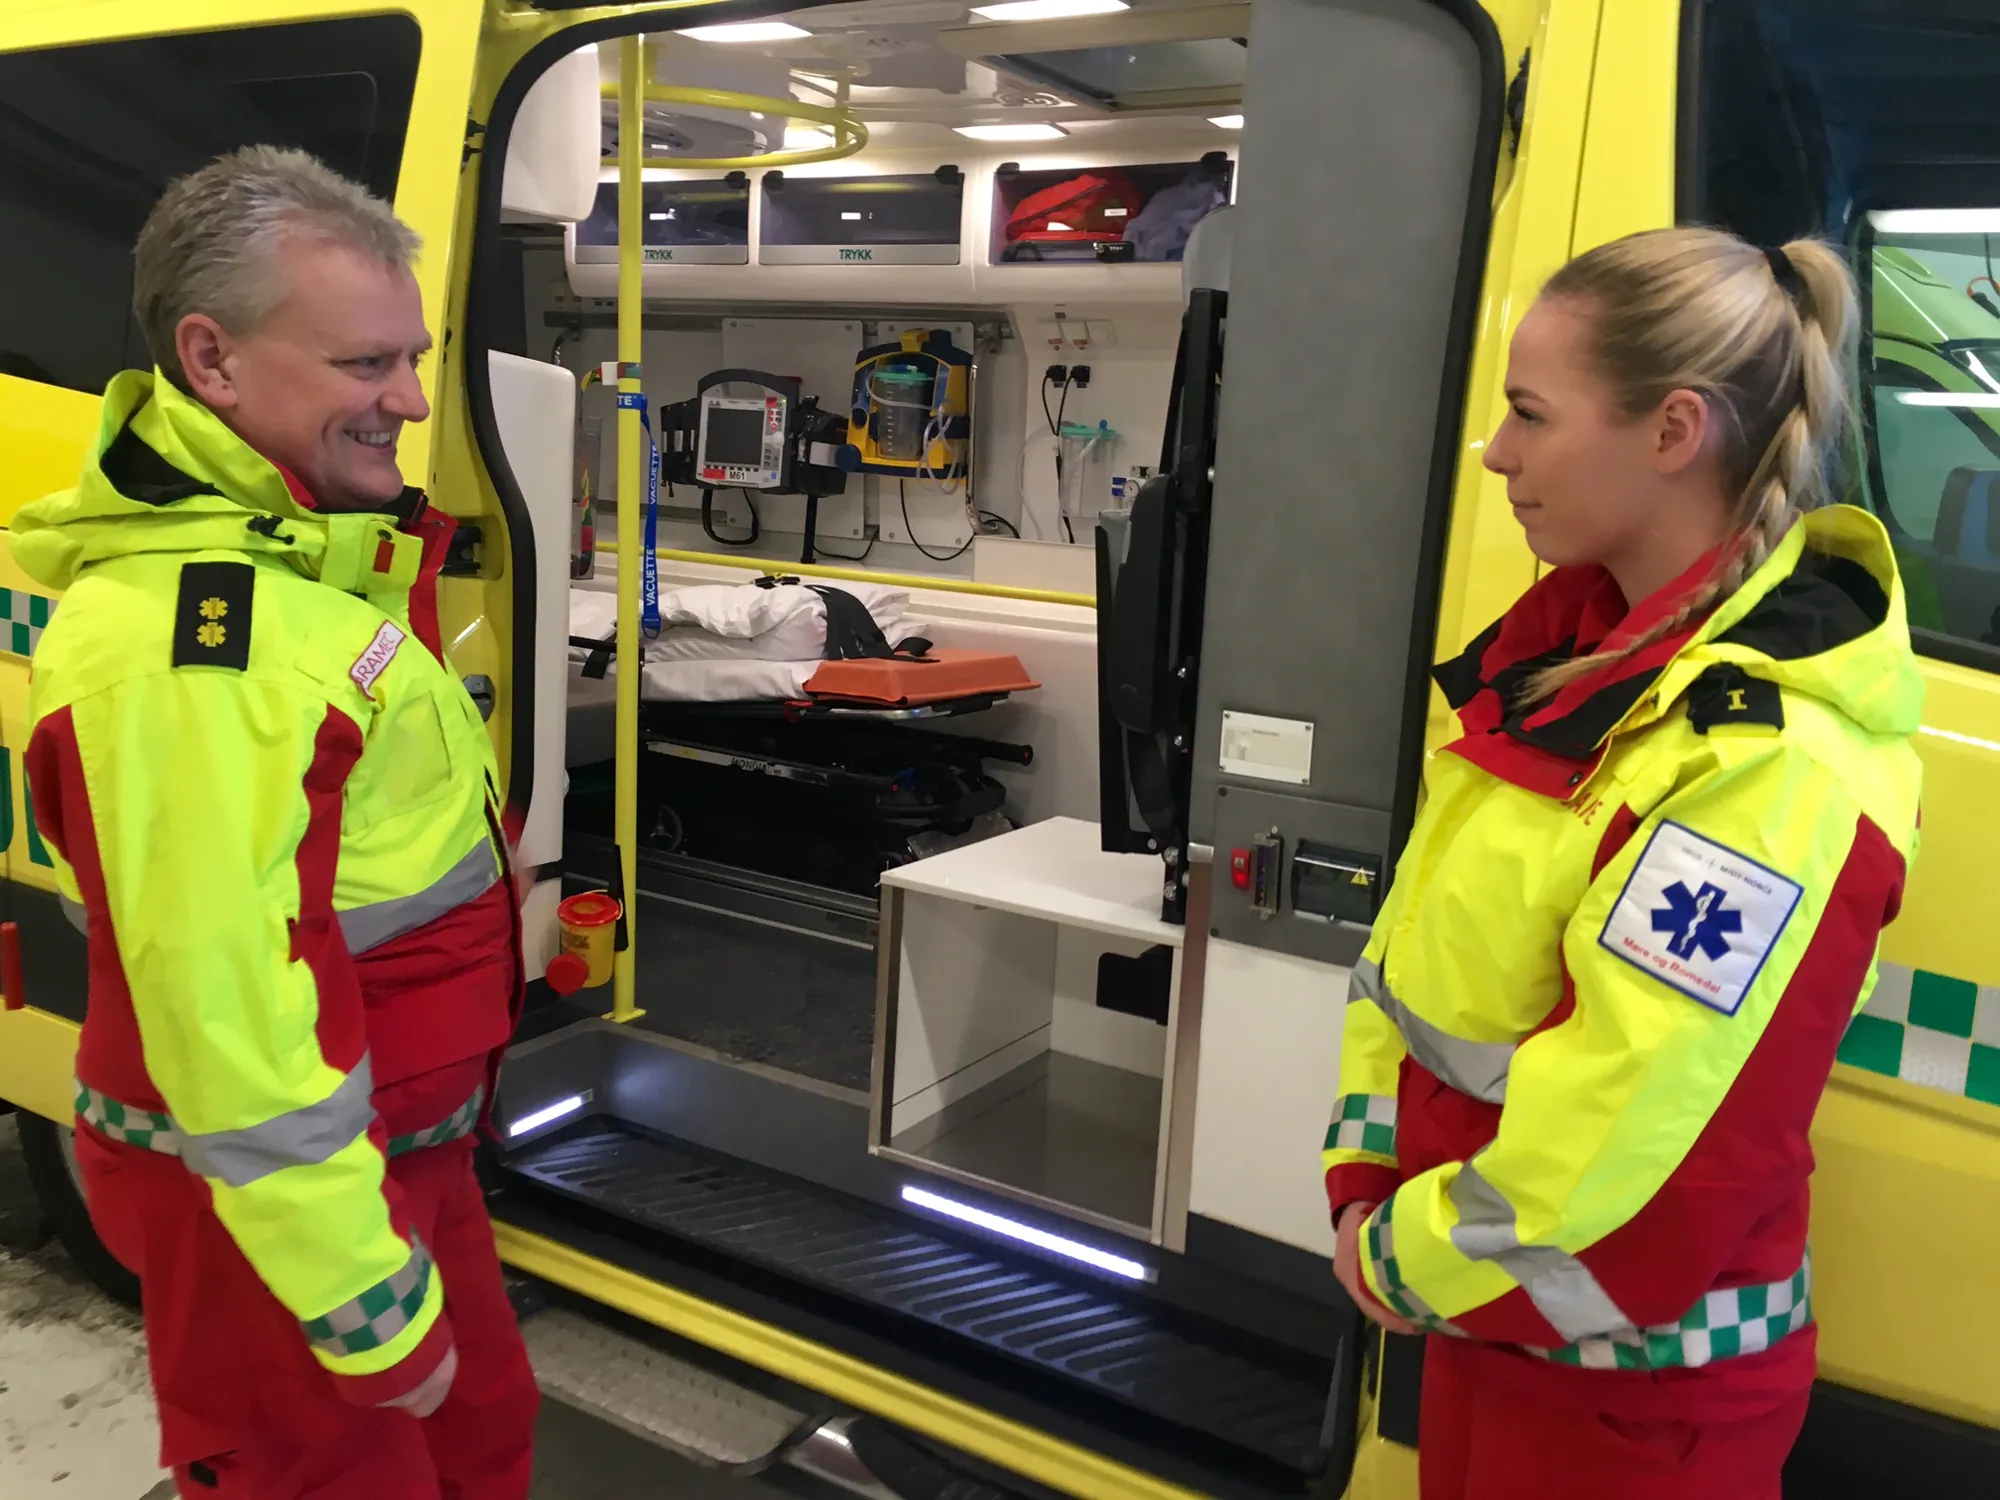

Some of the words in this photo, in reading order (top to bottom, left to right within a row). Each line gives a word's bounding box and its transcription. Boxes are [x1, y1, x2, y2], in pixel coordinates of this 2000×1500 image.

[644, 249, 673, 261] TRYKK
[839, 249, 872, 261] TRYKK
[729, 471, 745, 480] M61
[646, 548, 656, 607] VACUETTE
